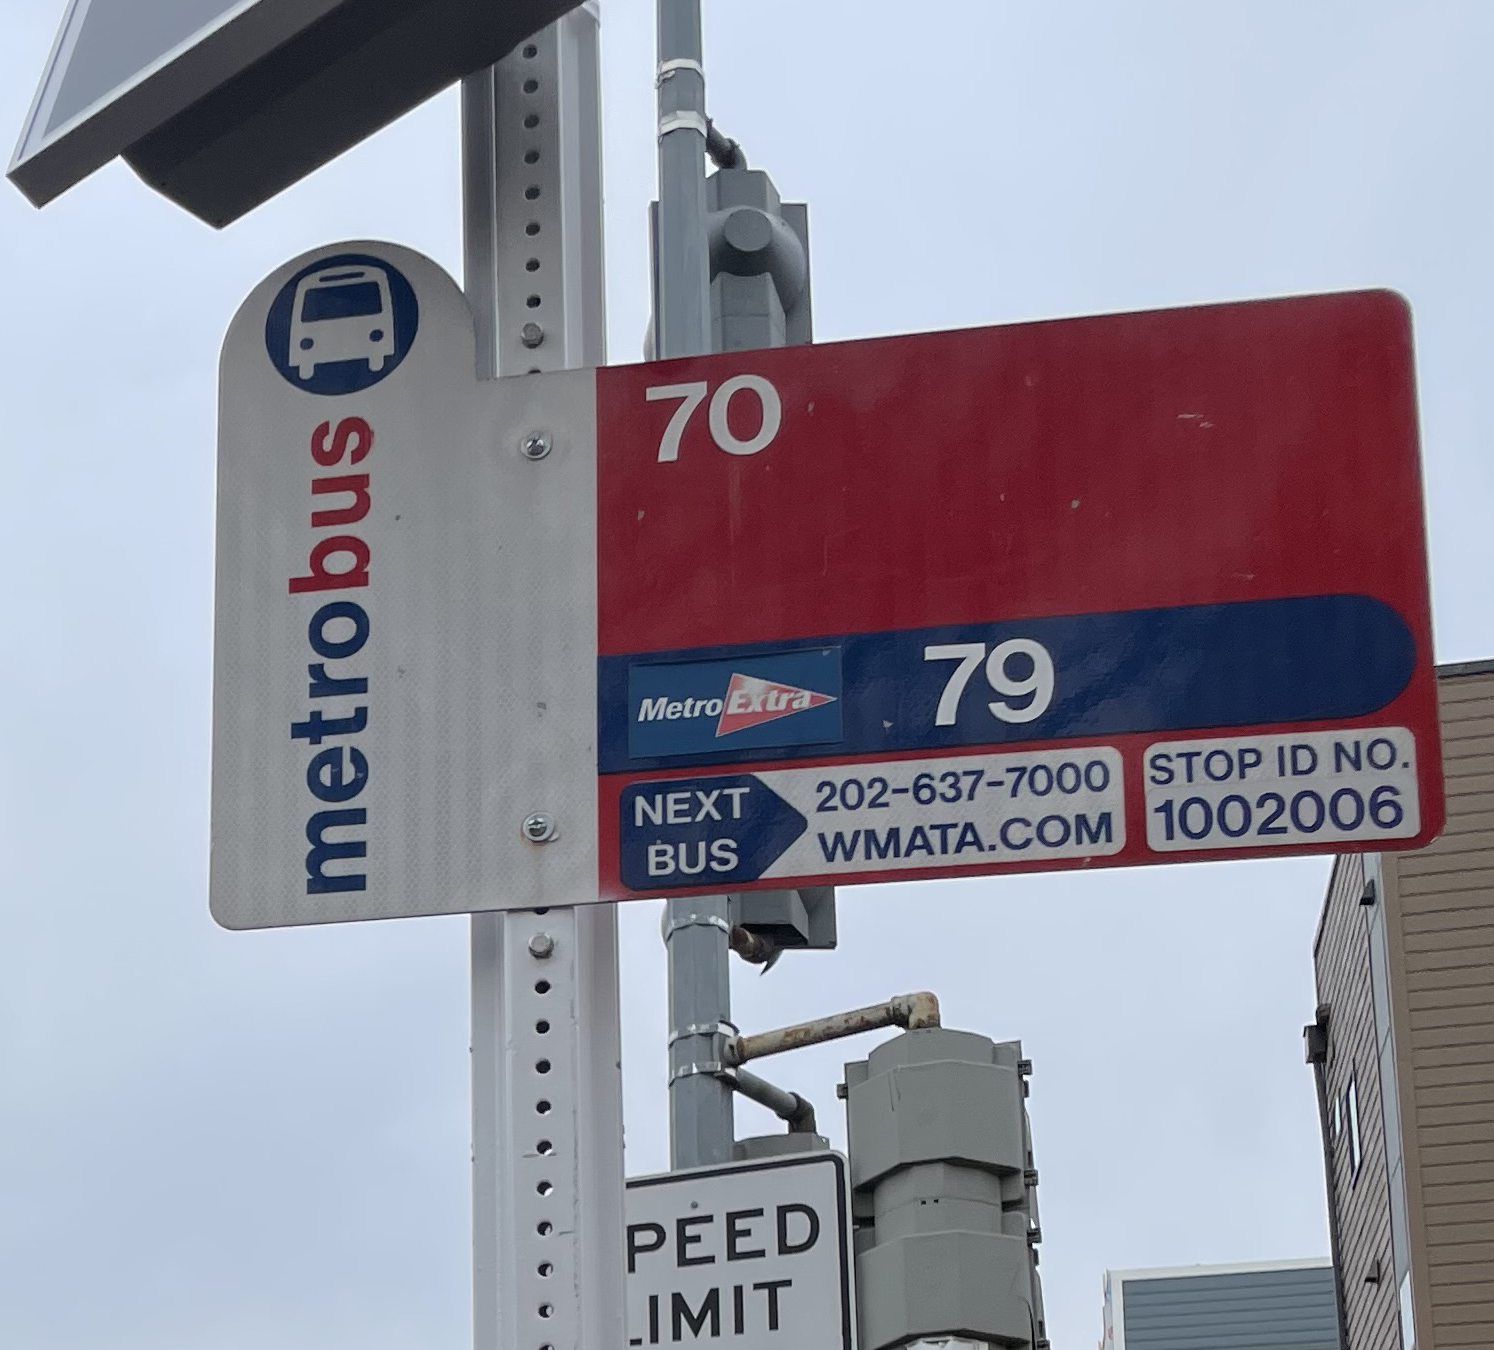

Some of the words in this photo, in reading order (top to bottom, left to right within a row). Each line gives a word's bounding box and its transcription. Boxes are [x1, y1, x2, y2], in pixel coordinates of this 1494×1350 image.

[645, 375, 783, 463] 70
[289, 415, 374, 895] metrobus
[923, 638, 1055, 727] 79
[815, 759, 1111, 812] 202-637-7000
[1149, 747, 1263, 786] STOP
[1277, 743, 1318, 778] ID
[1334, 737, 1410, 773] NO.
[633, 786, 750, 827] NEXT
[1154, 785, 1403, 841] 1002006
[647, 838, 739, 877] BUS
[817, 811, 1114, 863] WMATA.COM
[627, 1203, 820, 1274] PEED
